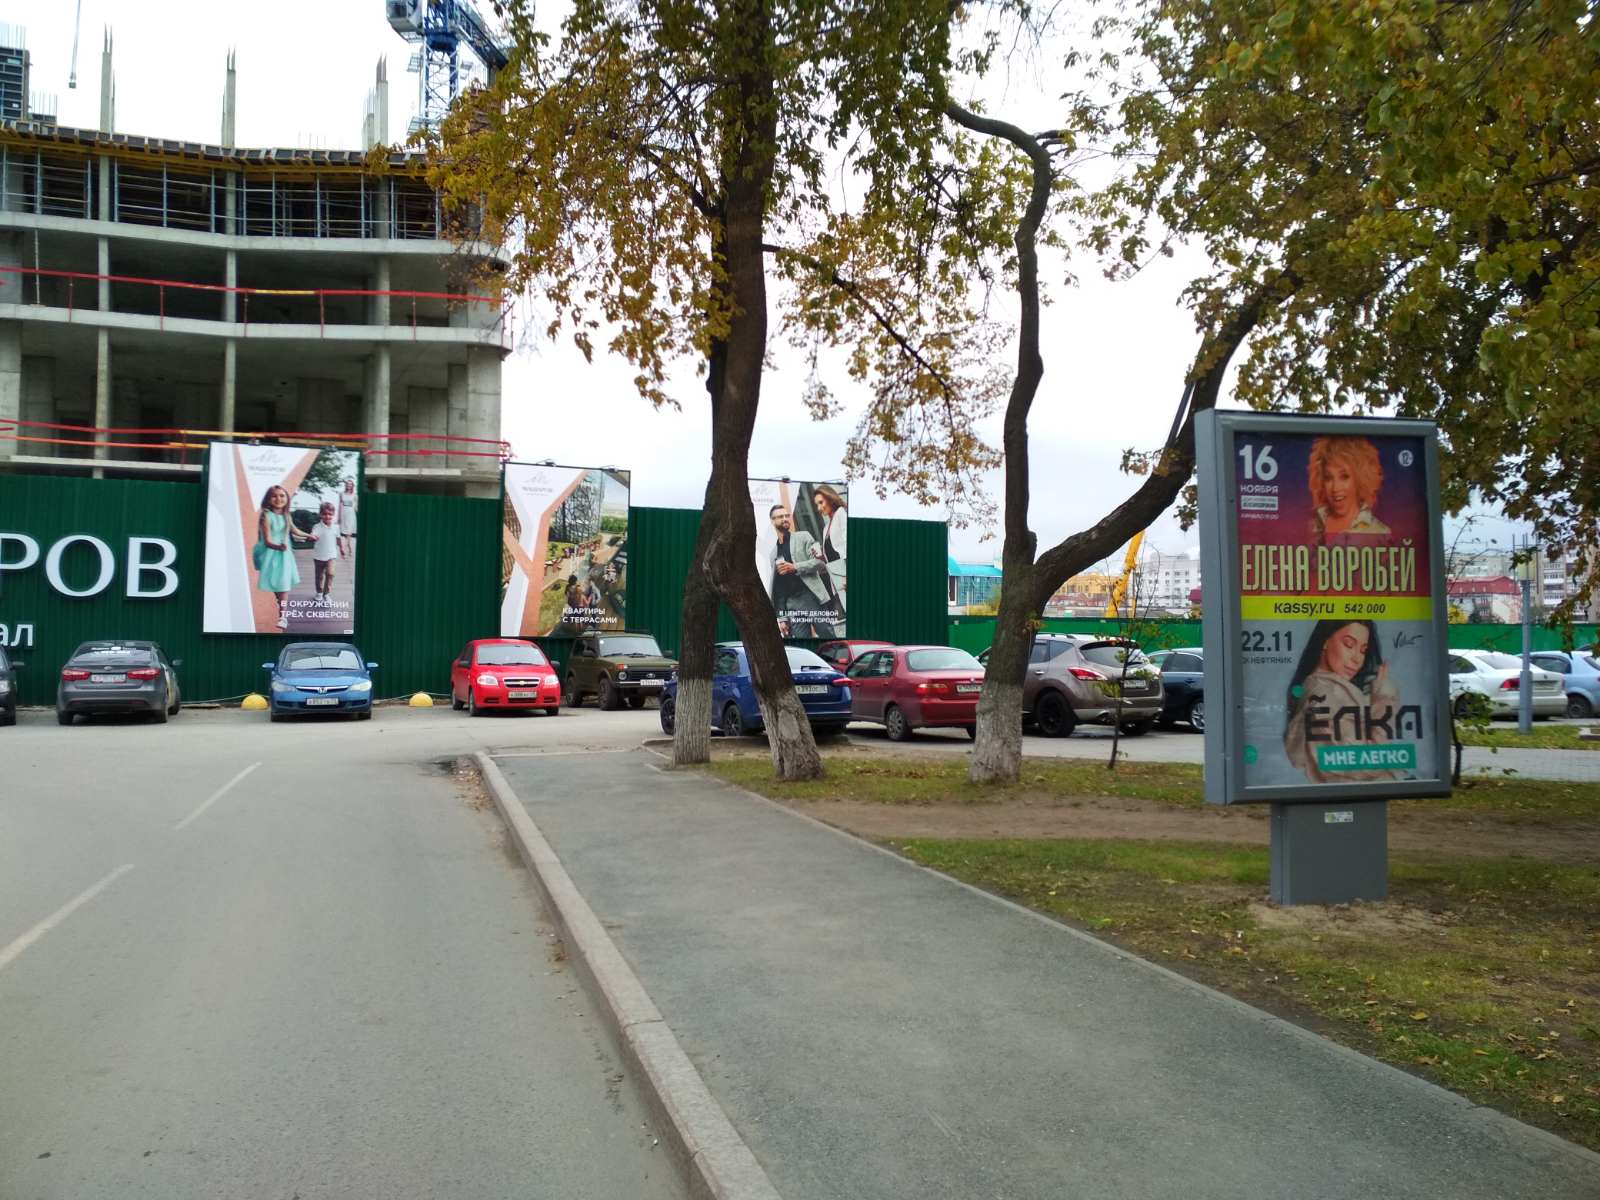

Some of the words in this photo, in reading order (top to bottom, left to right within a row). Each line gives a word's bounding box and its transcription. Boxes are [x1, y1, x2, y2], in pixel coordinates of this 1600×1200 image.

[1239, 444, 1279, 482] 16
[1240, 485, 1279, 495] НОЯБРЯ
[1242, 544, 1310, 592] ЕЛЕНА
[1318, 538, 1416, 593] ВОРОБЕЙ
[280, 600, 288, 608] В
[289, 600, 349, 608] ОКРУЖЕНИИ
[1274, 601, 1335, 616] kassy.ru
[1344, 603, 1363, 613] 542
[1366, 603, 1386, 613] 000
[280, 610, 304, 618] ТРЁХ
[306, 610, 349, 619] СКВЕРОВ
[563, 607, 606, 615] КВАРТИРЫ
[809, 609, 839, 617] ДЕЛОВОЙ
[570, 616, 617, 624] ТЕРРАСАМИ
[1241, 630, 1292, 652] 22.11
[1250, 656, 1292, 665] НЕФТЯНИК
[1323, 750, 1357, 766] МНЕ
[1359, 749, 1410, 765] ЛЕГКО
